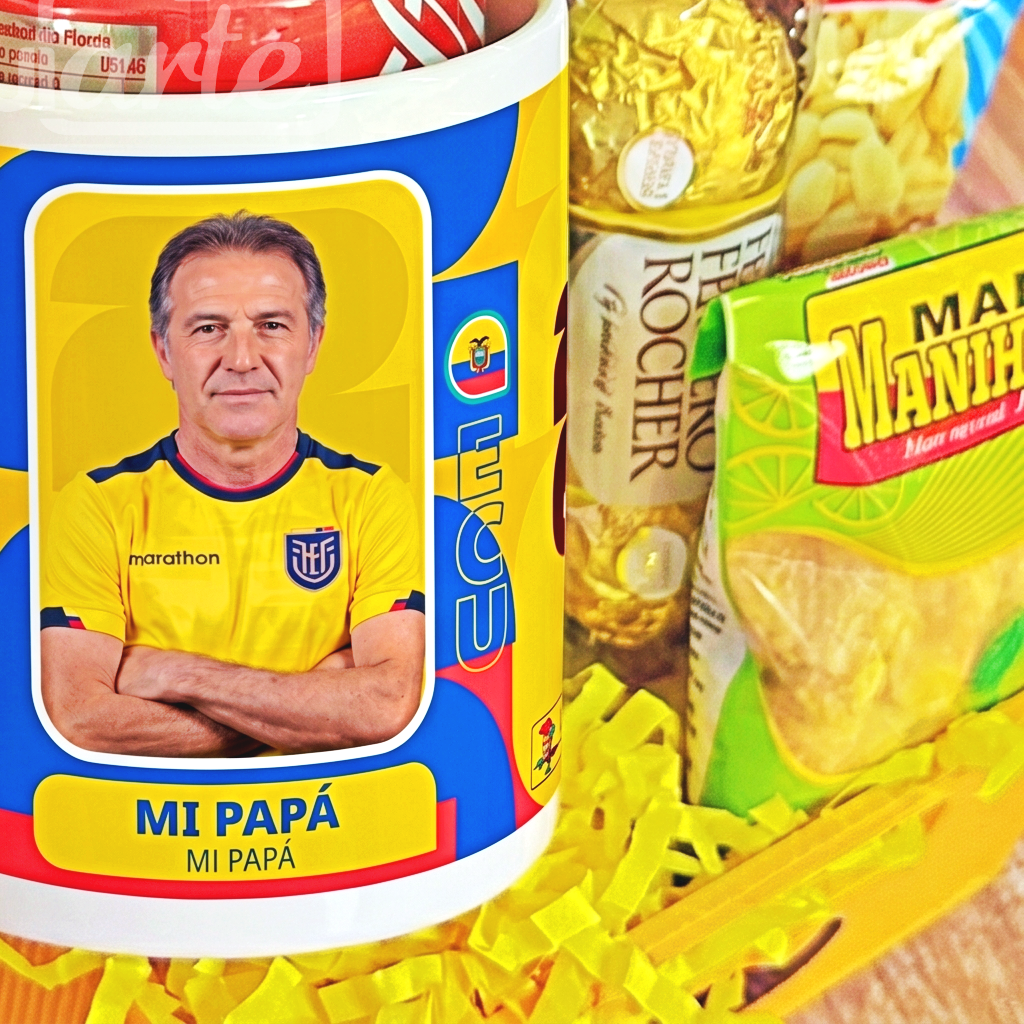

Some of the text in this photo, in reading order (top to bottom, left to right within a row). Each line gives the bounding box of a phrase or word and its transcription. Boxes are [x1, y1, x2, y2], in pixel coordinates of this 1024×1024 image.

[630, 251, 694, 482] ROCHER
[128, 550, 220, 567] marathon
[136, 782, 340, 837] MI PAPÁ
[187, 838, 296, 873] MI PAPÁ
